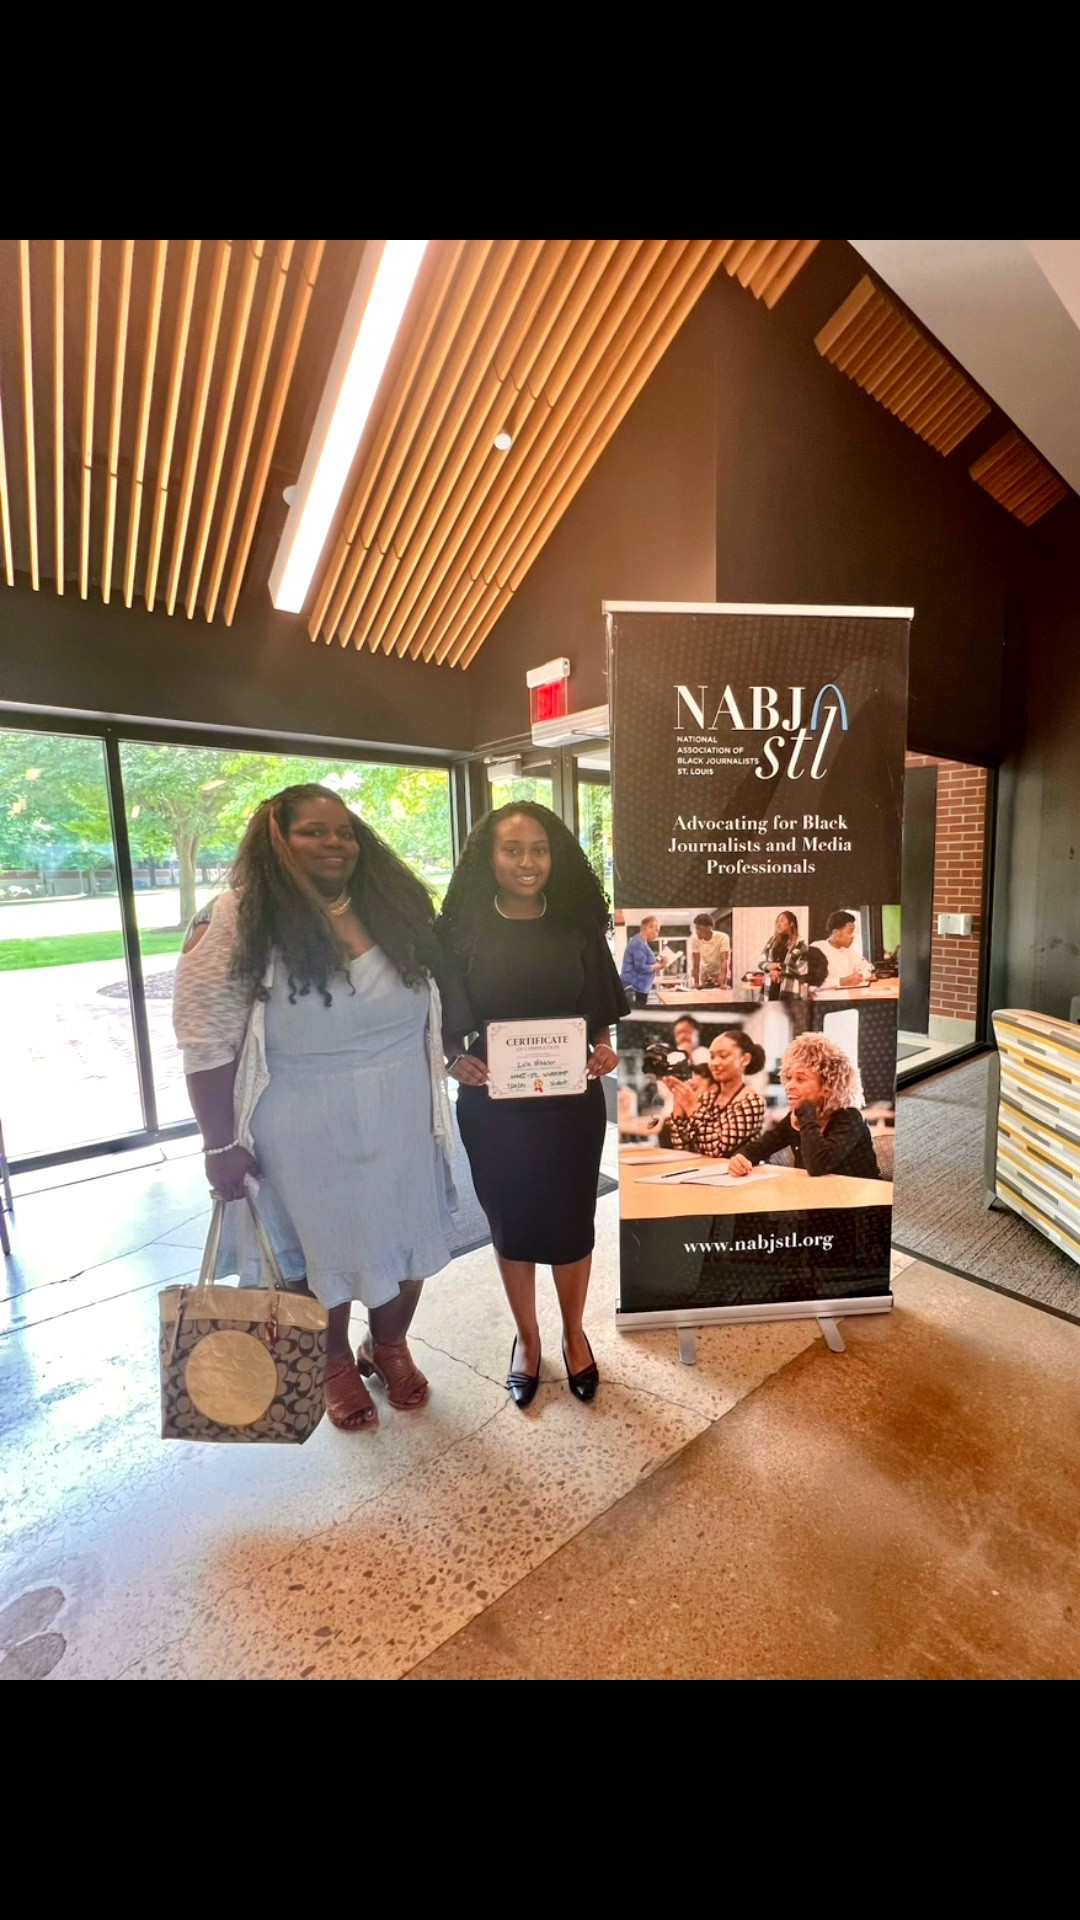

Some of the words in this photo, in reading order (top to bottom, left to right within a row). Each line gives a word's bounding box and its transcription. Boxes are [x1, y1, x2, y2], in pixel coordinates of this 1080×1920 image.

[673, 684, 806, 731] NABJ
[755, 706, 838, 779] stl
[677, 757, 704, 765] BLACK
[705, 757, 759, 765] JOURNALISTS
[673, 815, 768, 835] Advocating
[773, 815, 798, 830] for
[802, 814, 848, 830] Black
[668, 837, 761, 853] Journalists
[765, 837, 796, 852] and
[802, 836, 852, 852] Media
[707, 859, 815, 875] Professionals
[506, 1035, 569, 1047] CERTIFICATE
[683, 1232, 834, 1254] www.nabjstl.org
